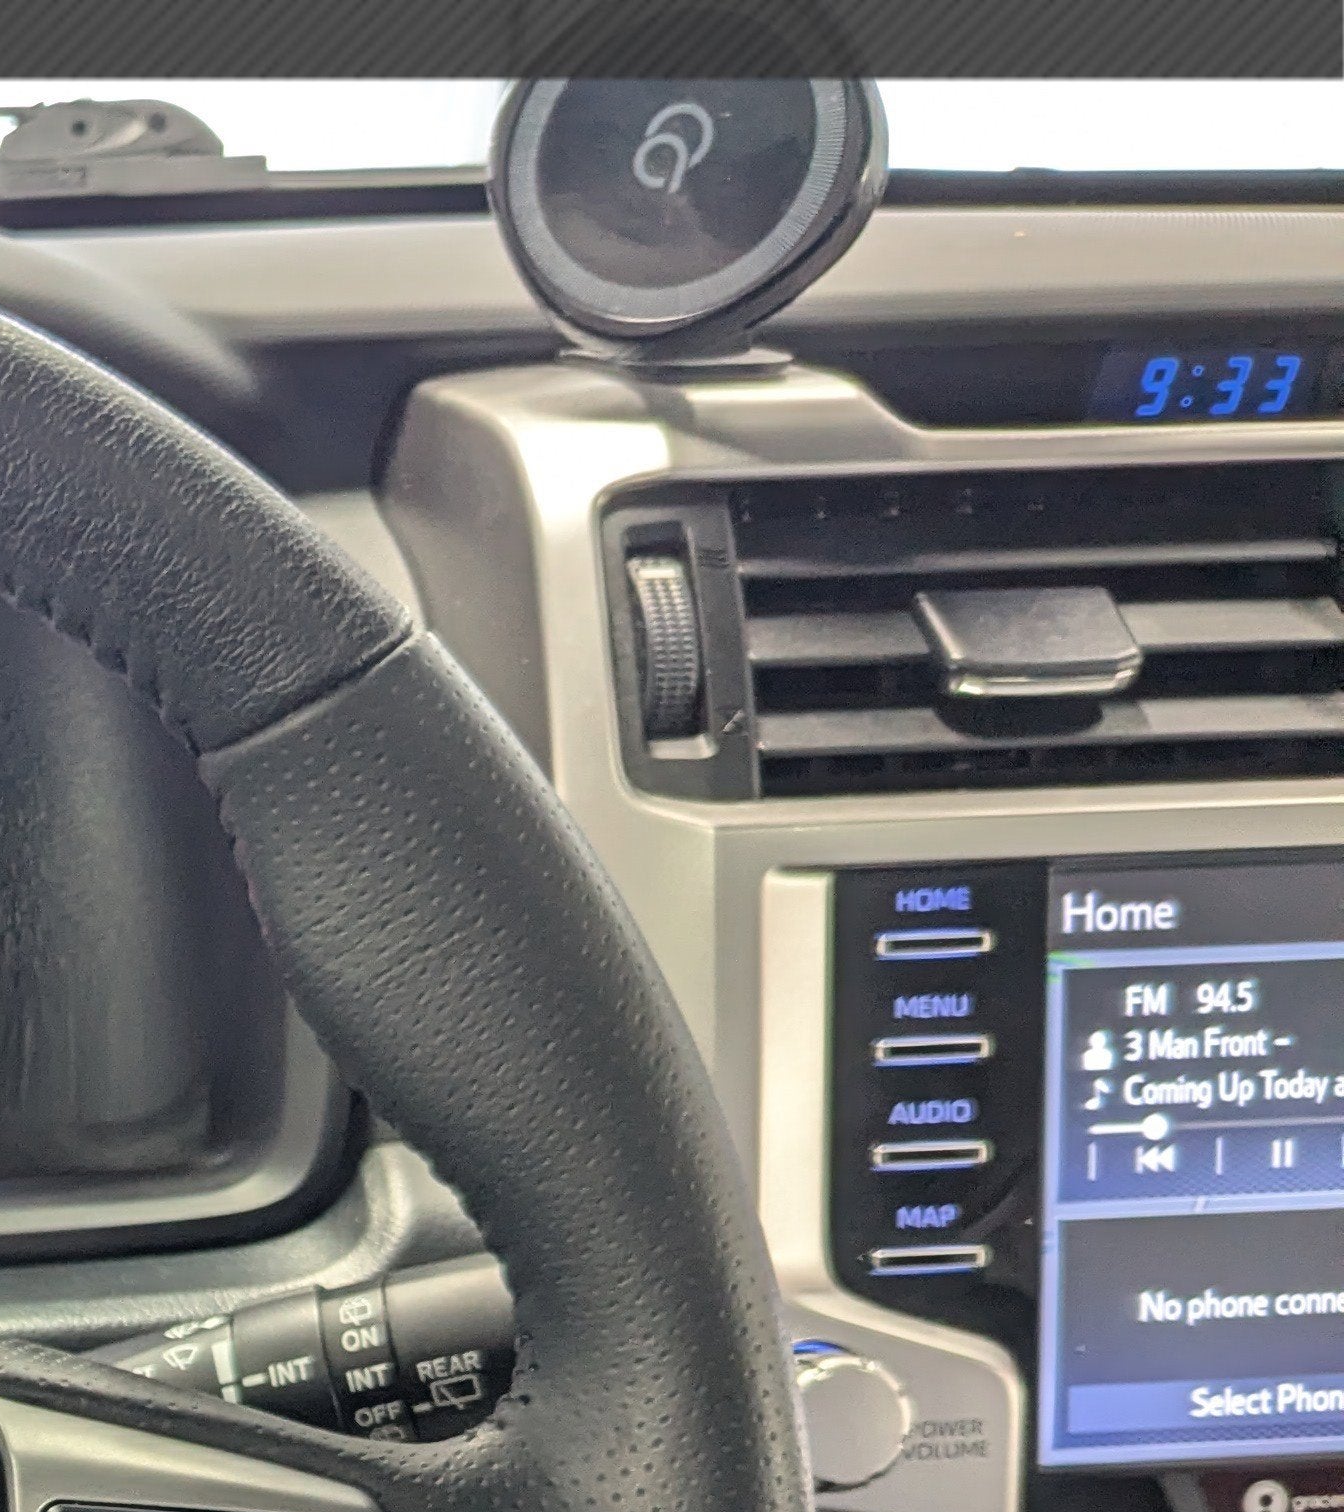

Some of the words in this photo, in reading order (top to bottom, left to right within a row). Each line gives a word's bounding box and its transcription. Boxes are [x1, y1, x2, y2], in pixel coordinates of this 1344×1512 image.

[1135, 354, 1302, 418] 9:33
[895, 887, 971, 912] HOME
[1061, 890, 1180, 934] Home
[893, 993, 972, 1018] MENU
[1124, 982, 1170, 1017] FM
[1193, 978, 1256, 1015] 94.5
[1123, 1029, 1144, 1062] 3
[1148, 1028, 1198, 1060] Man
[1203, 1025, 1269, 1058] Front
[1123, 1073, 1212, 1109] Coming
[1218, 1070, 1256, 1107] Up
[1258, 1068, 1330, 1104] Today
[887, 1099, 975, 1125] AUDIO
[895, 1205, 958, 1229] MAP
[1138, 1289, 1183, 1322] No
[1187, 1288, 1269, 1326] phone
[340, 1325, 383, 1353] ON
[267, 1356, 314, 1388] INT
[344, 1362, 394, 1393] INT
[416, 1350, 482, 1383] REAR
[354, 1400, 405, 1428] OFF
[1190, 1385, 1273, 1418] Select
[1276, 1382, 1344, 1413] Phon
